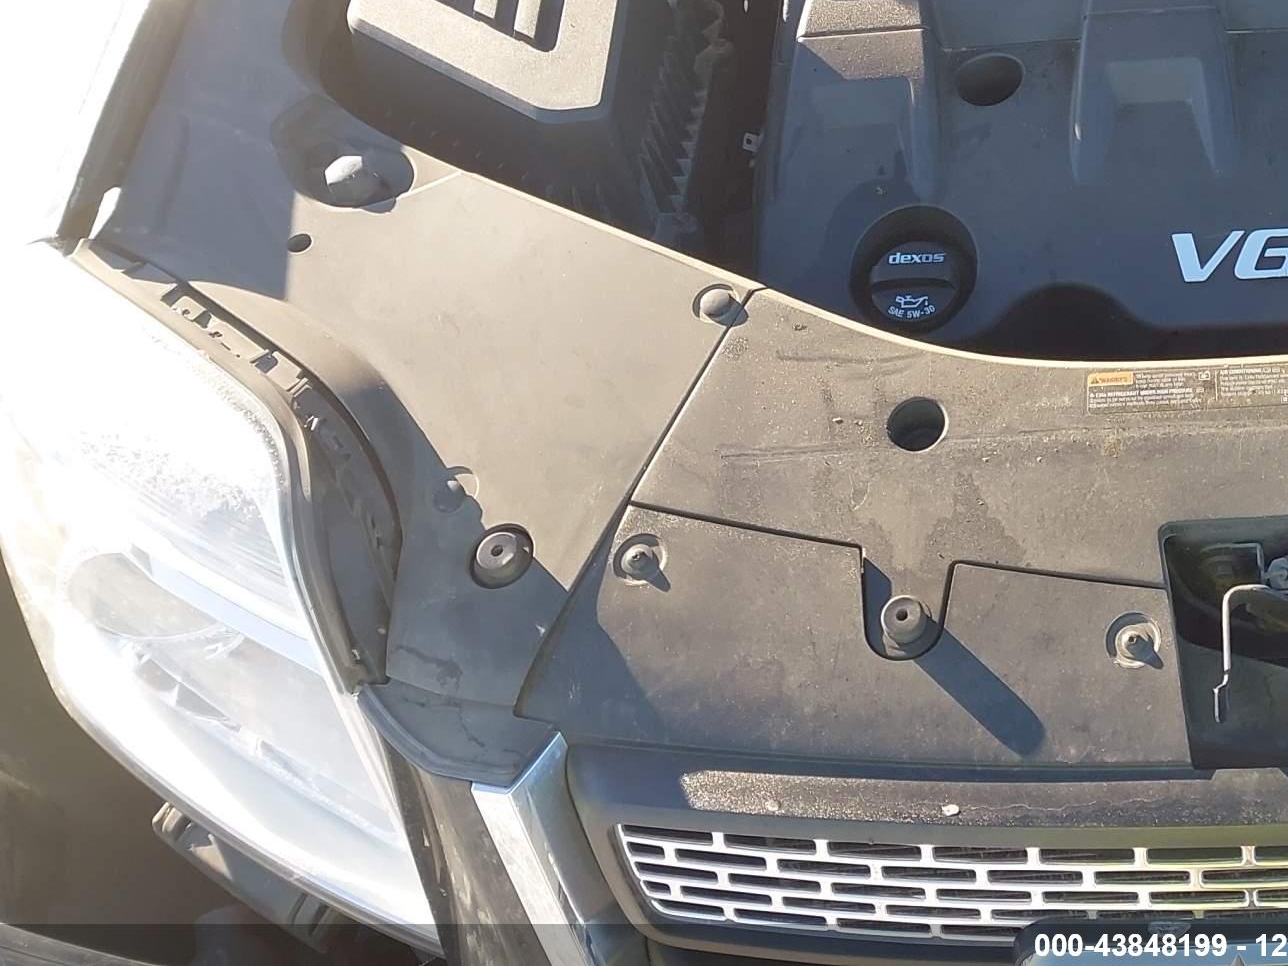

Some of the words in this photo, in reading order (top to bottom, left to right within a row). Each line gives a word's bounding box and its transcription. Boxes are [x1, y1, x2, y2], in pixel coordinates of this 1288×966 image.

[888, 252, 947, 264] dexos
[888, 306, 904, 318] SAE
[907, 305, 936, 318] 5W-30
